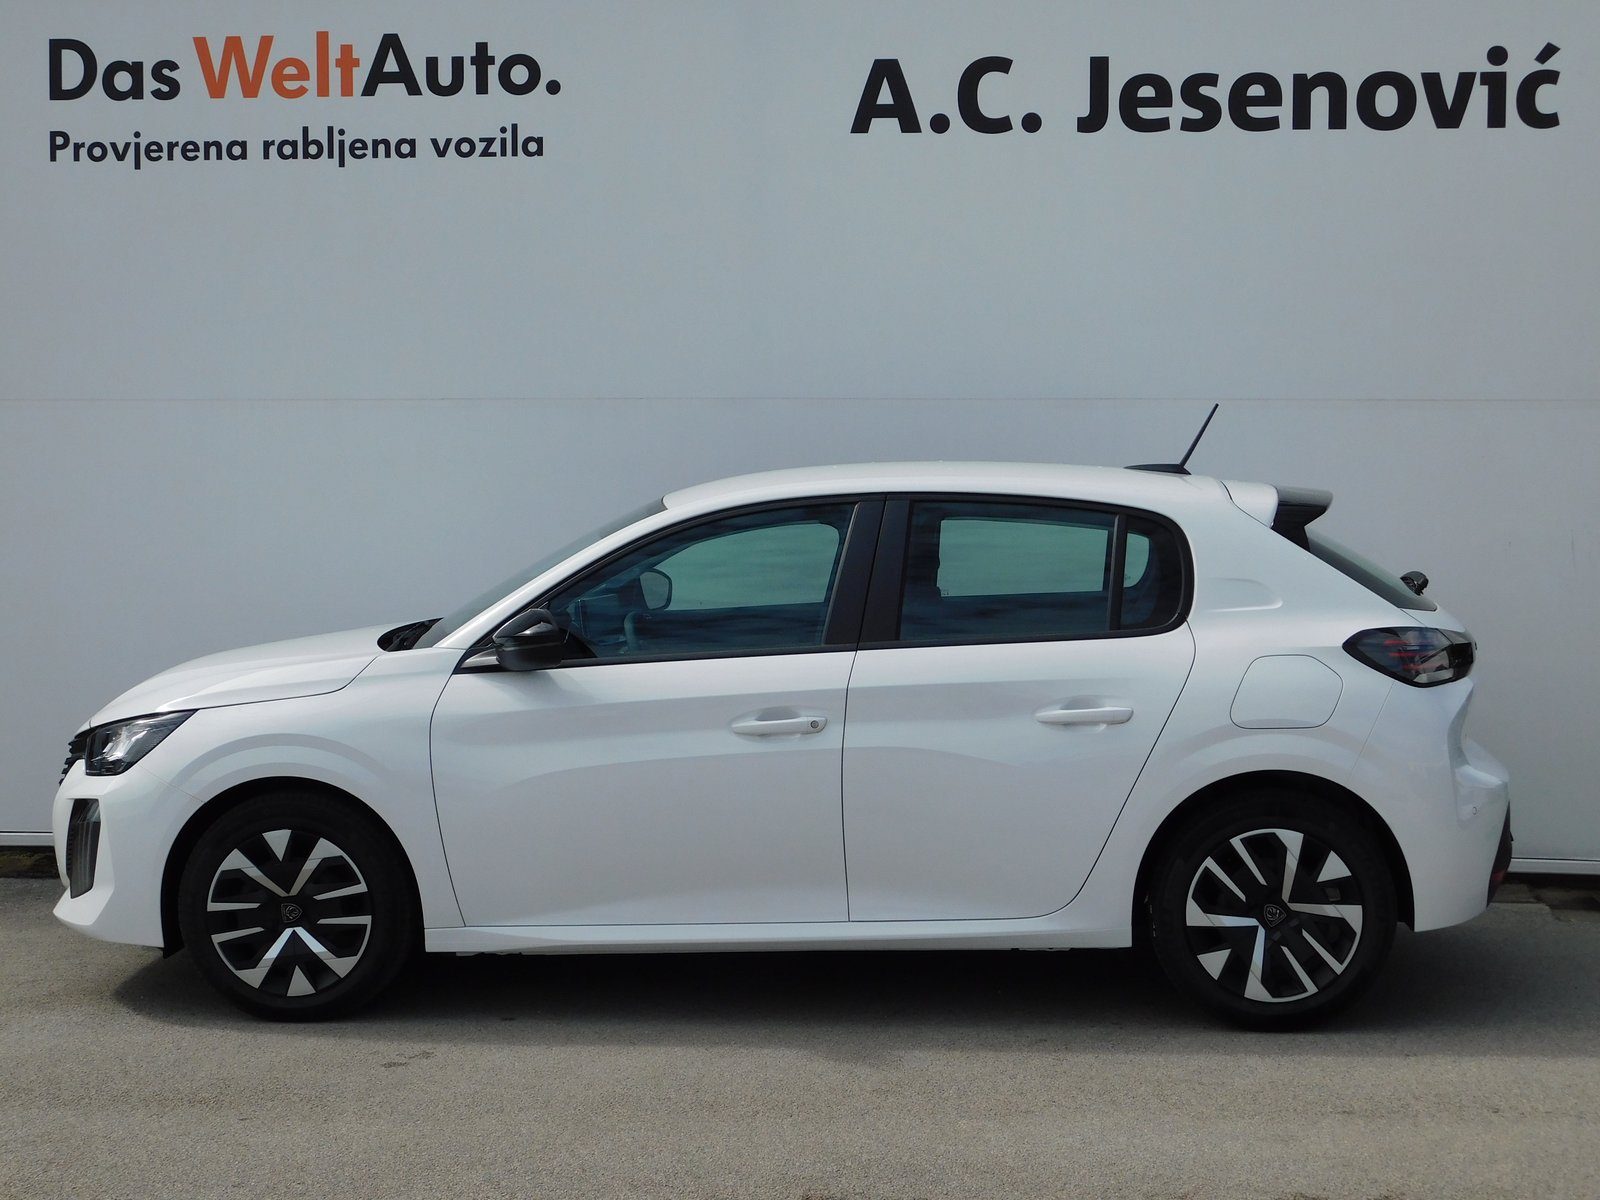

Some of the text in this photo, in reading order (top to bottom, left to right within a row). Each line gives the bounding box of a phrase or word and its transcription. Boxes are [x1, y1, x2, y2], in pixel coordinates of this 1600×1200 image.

[49, 38, 181, 101] Das
[851, 42, 1561, 134] A.C. Jesenović
[50, 124, 544, 170] Provjerena rabljena vozila
